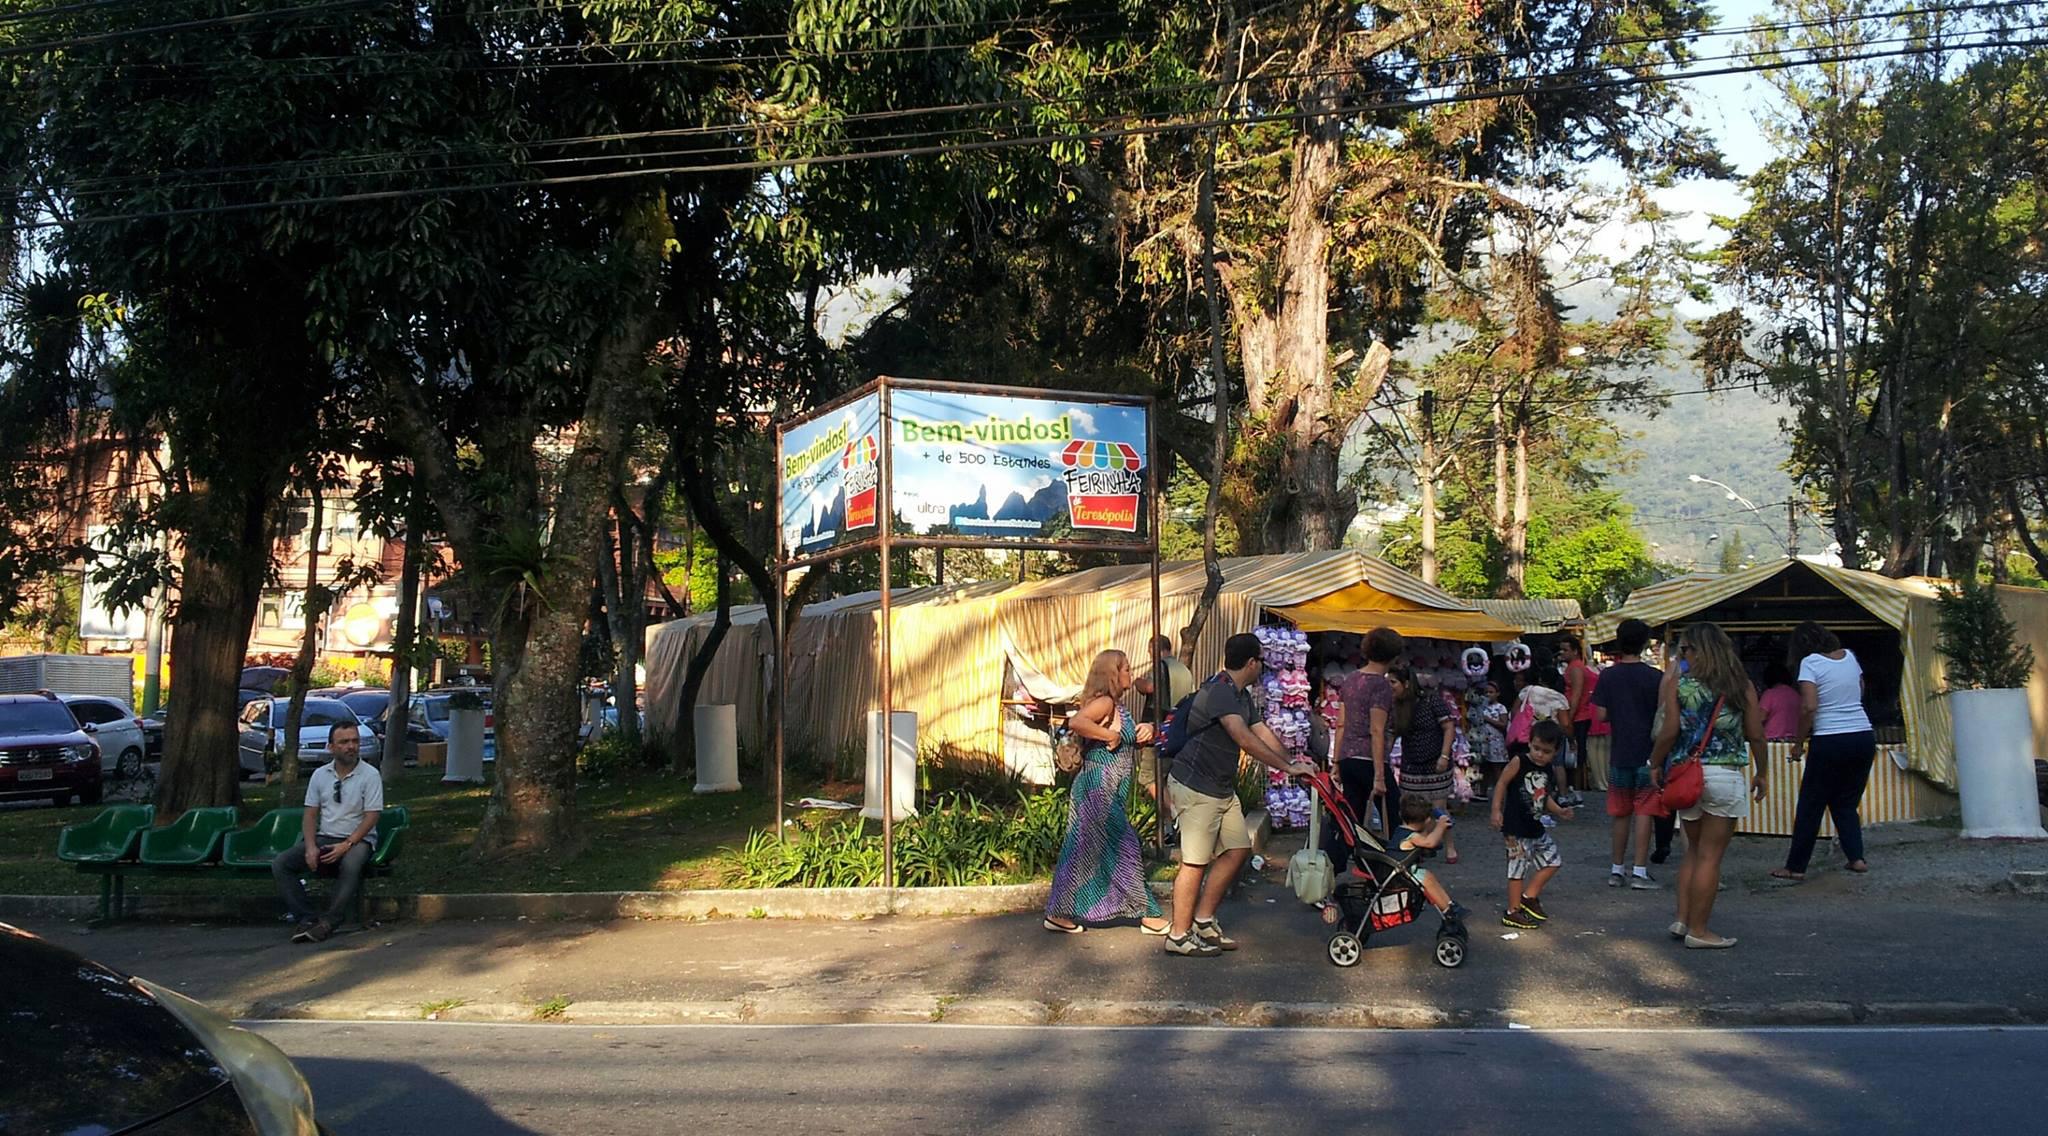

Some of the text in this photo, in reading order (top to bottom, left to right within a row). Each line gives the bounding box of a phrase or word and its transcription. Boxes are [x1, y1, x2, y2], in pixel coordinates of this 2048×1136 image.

[902, 416, 1070, 442] Bem-vindos!
[785, 421, 848, 479] Bem-vindos!
[938, 450, 952, 464] de
[959, 452, 986, 465] 500
[993, 455, 1051, 469] Estandes
[1063, 468, 1141, 493] FEIRINHA
[917, 501, 946, 514] ultra
[1073, 505, 1134, 525] Teresópolis
